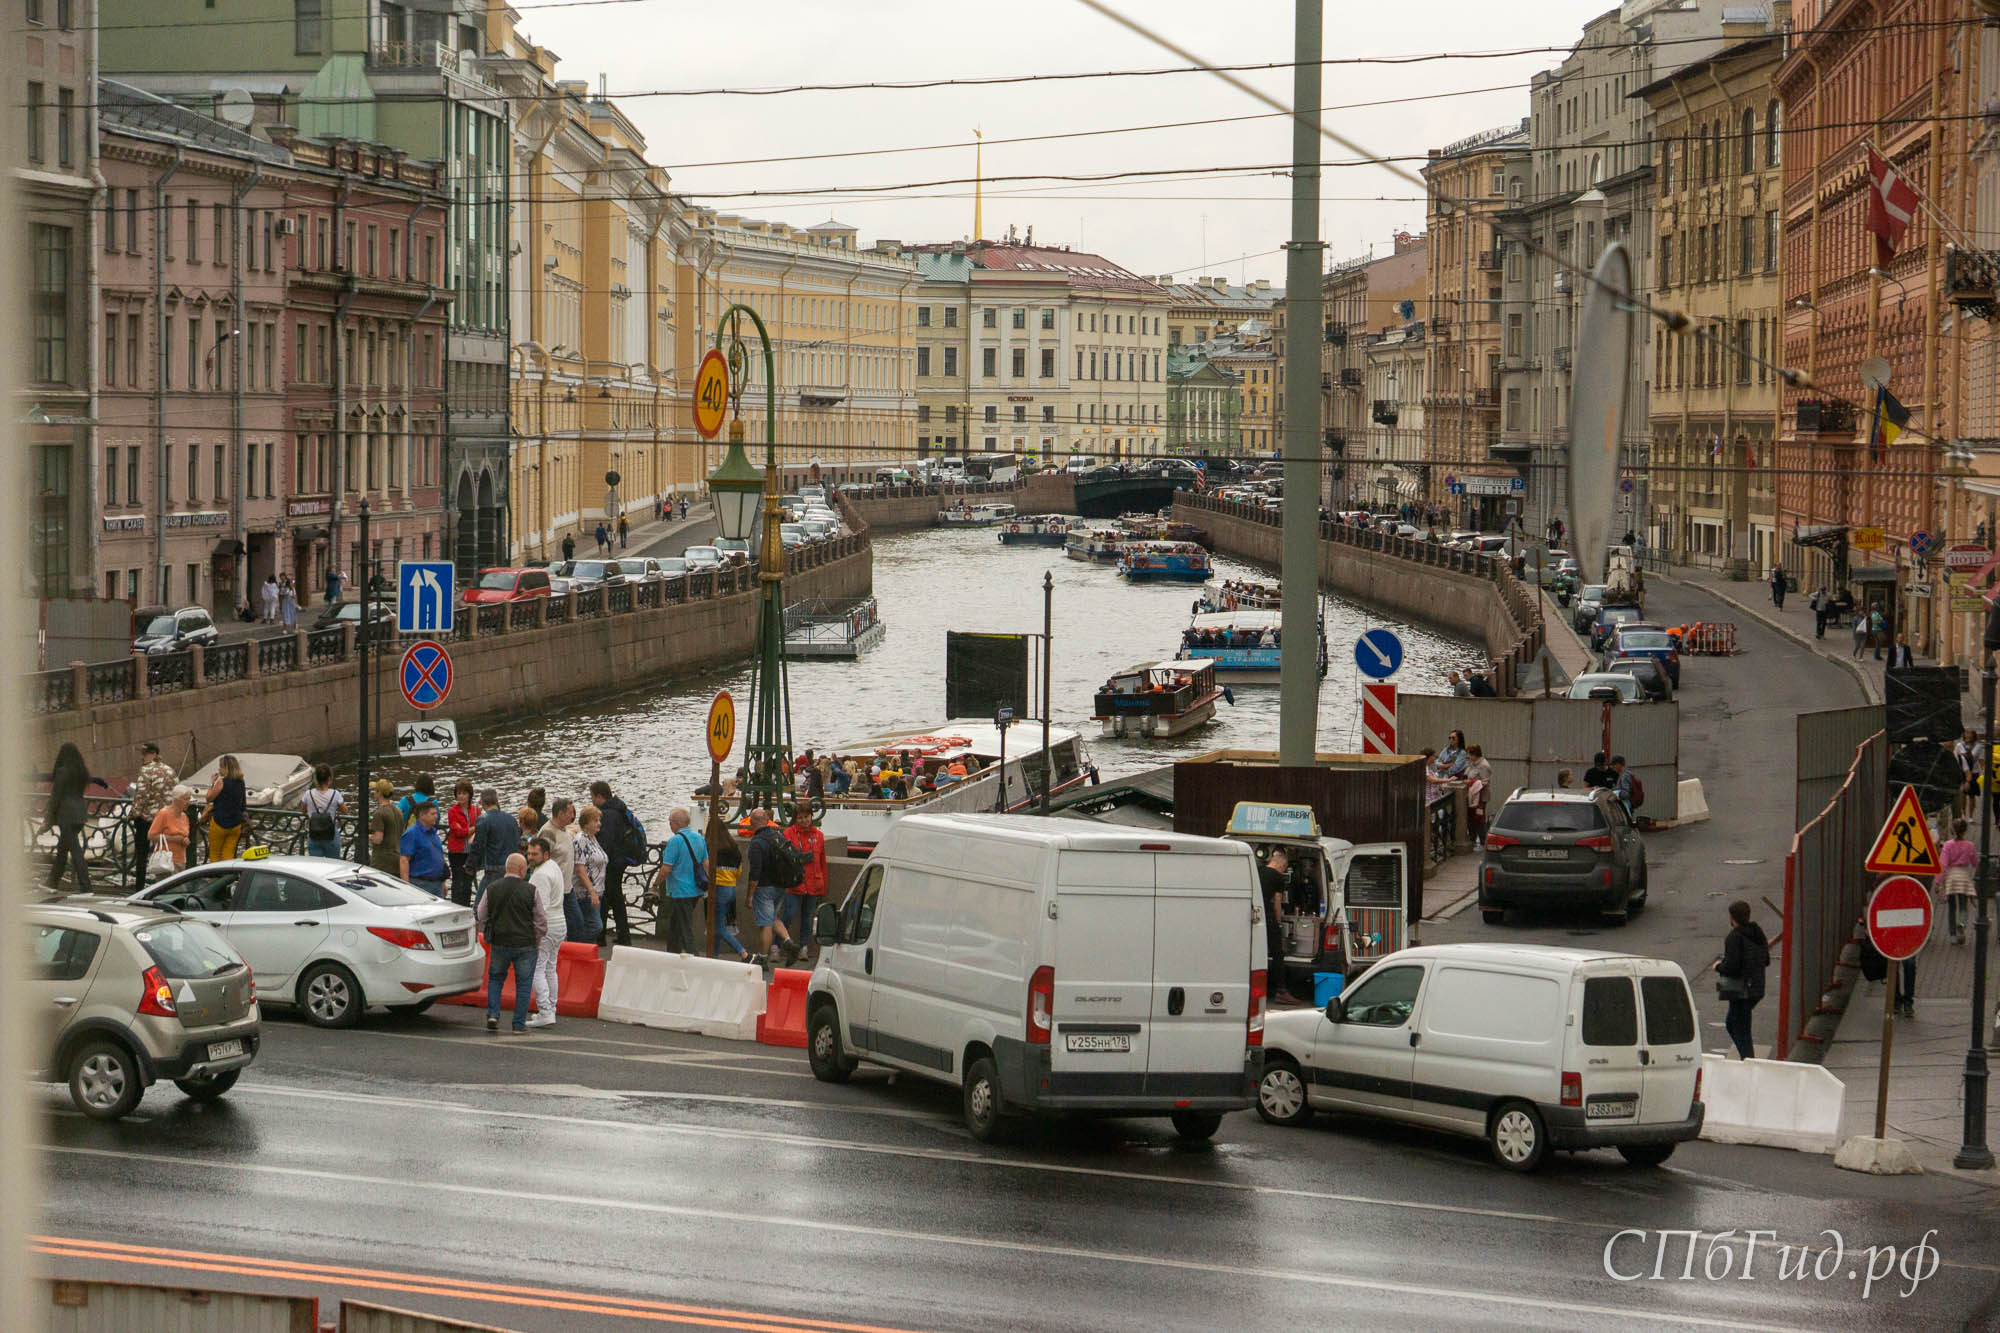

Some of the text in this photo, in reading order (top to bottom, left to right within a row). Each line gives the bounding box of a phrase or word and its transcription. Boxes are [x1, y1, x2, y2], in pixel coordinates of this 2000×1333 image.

[702, 376, 722, 412] 40
[713, 713, 730, 740] 40
[1112, 1036, 1127, 1046] 178
